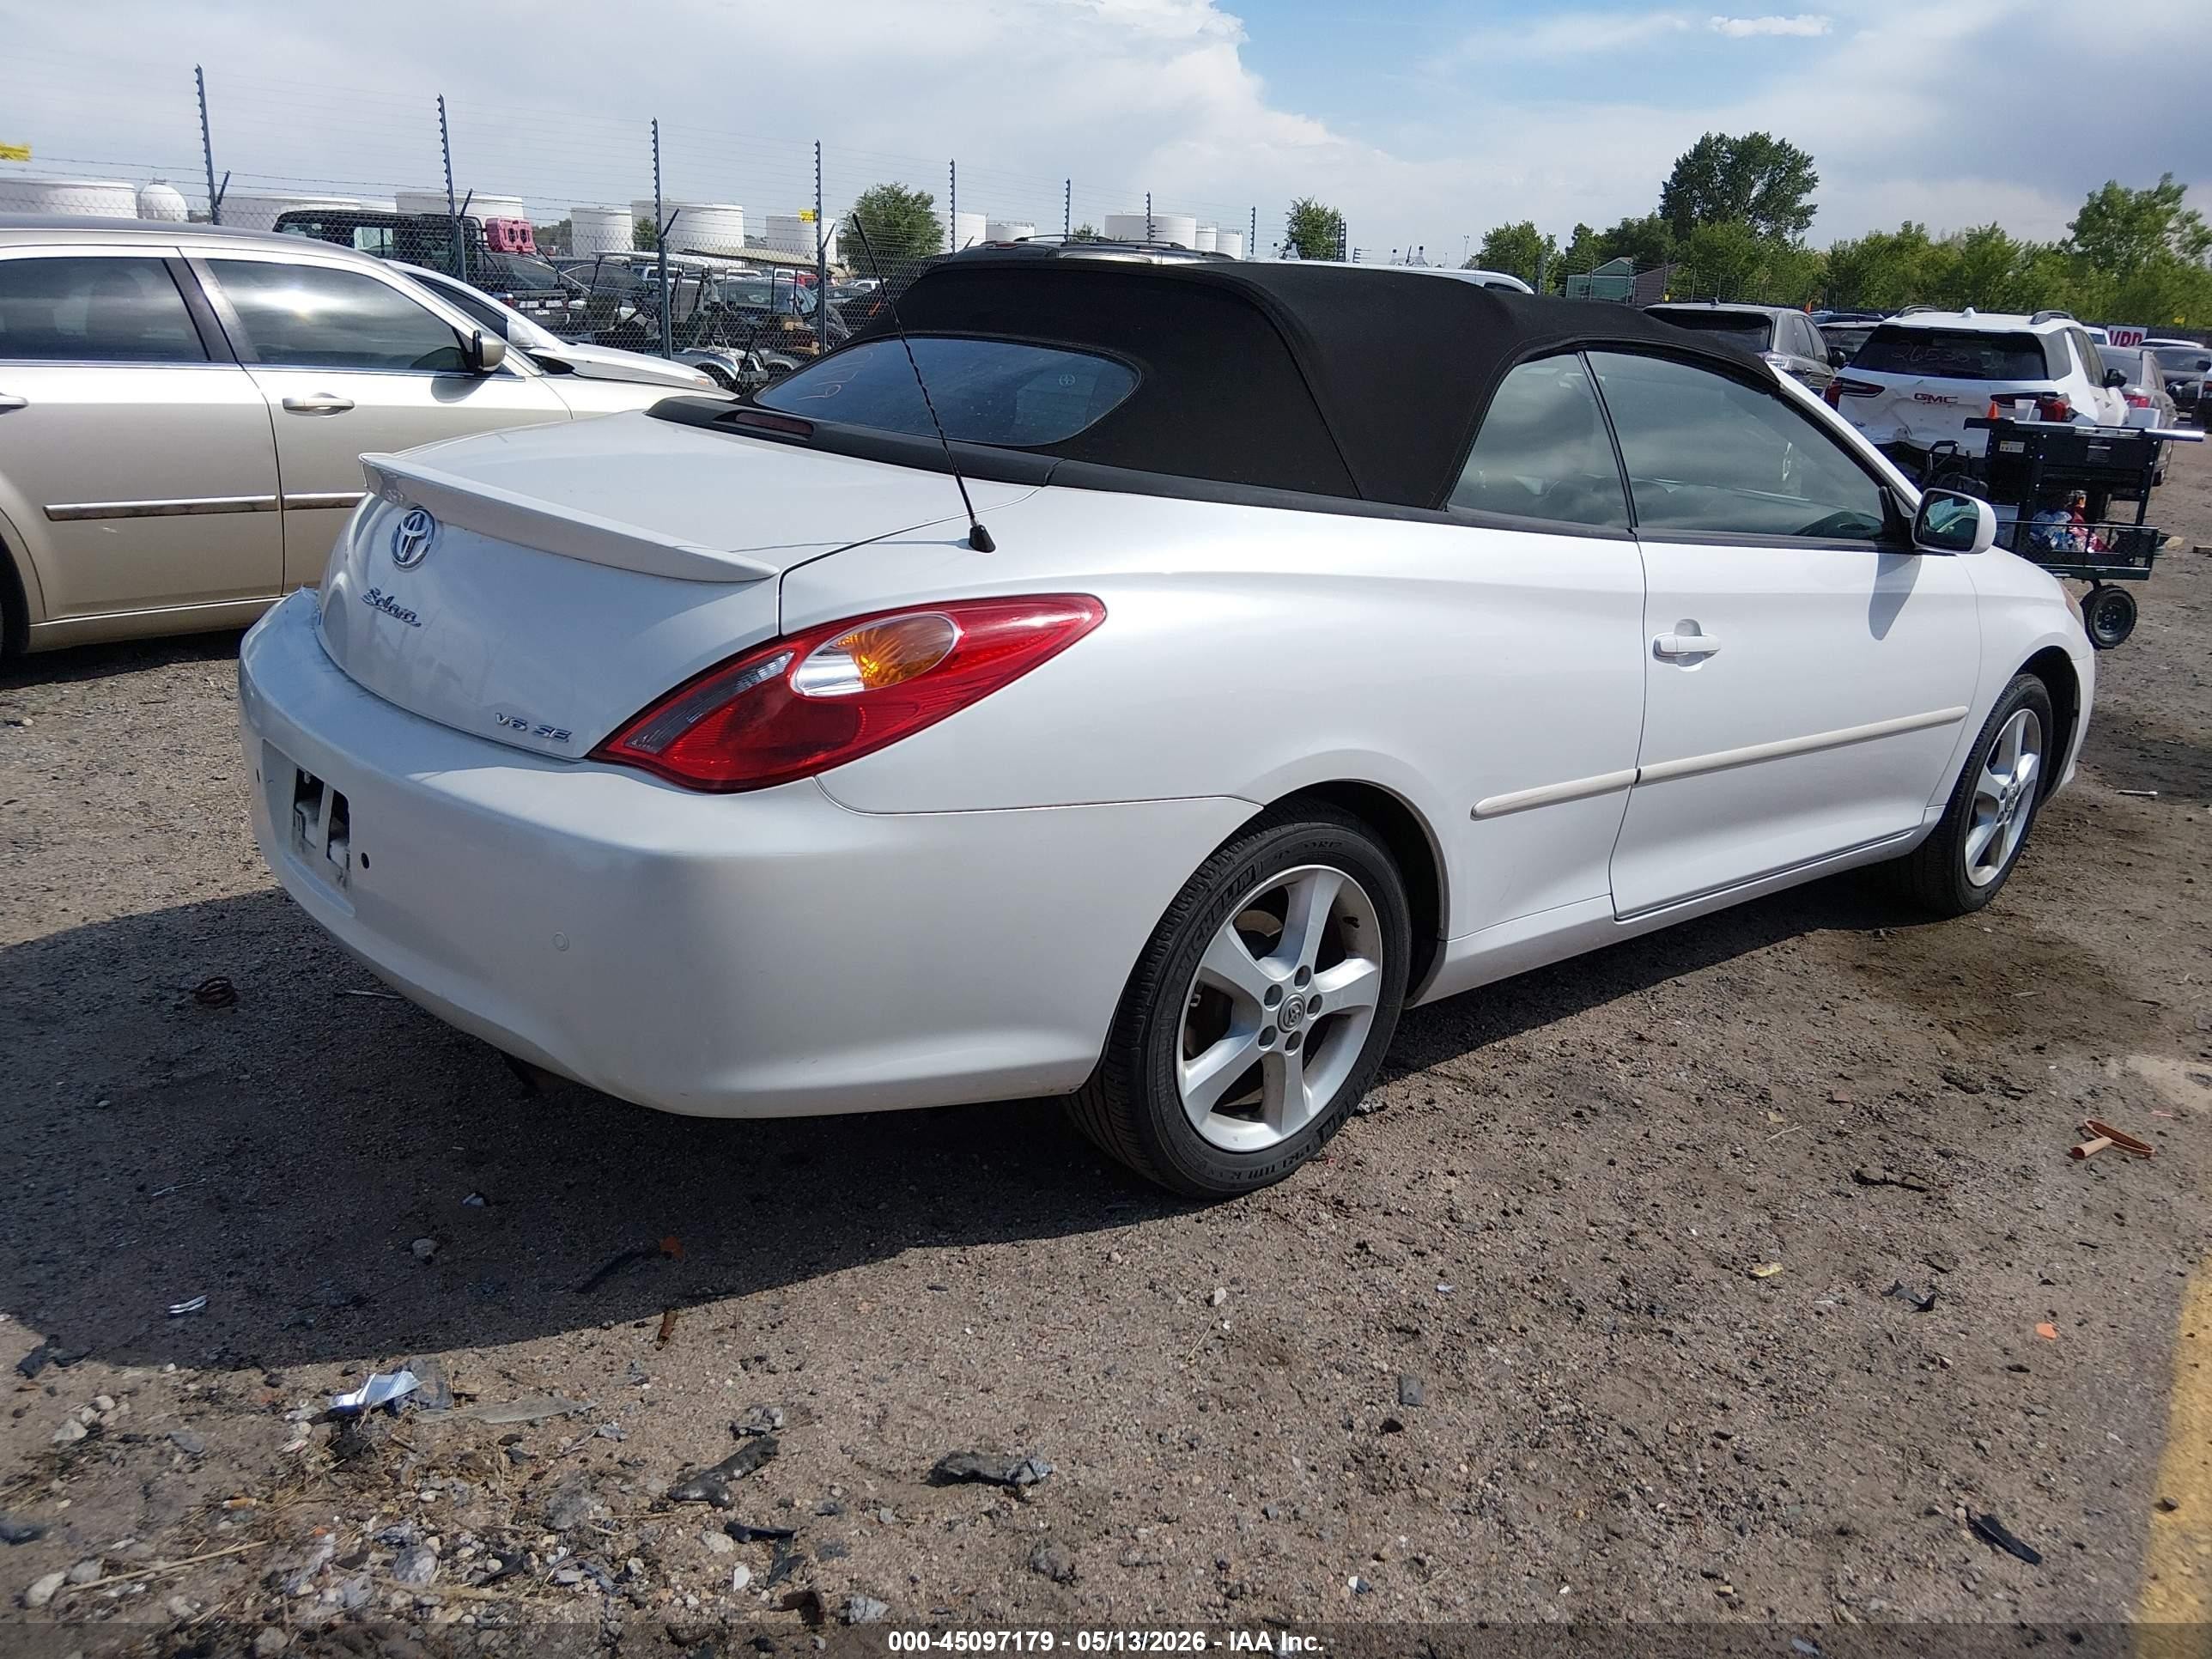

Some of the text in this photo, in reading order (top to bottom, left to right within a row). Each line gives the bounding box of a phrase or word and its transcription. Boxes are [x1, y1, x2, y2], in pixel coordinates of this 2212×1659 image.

[1913, 392, 1959, 404] GMC
[361, 587, 422, 628] Solara
[495, 712, 573, 743] V6 SE
[1175, 864, 1255, 981] MICHELIN
